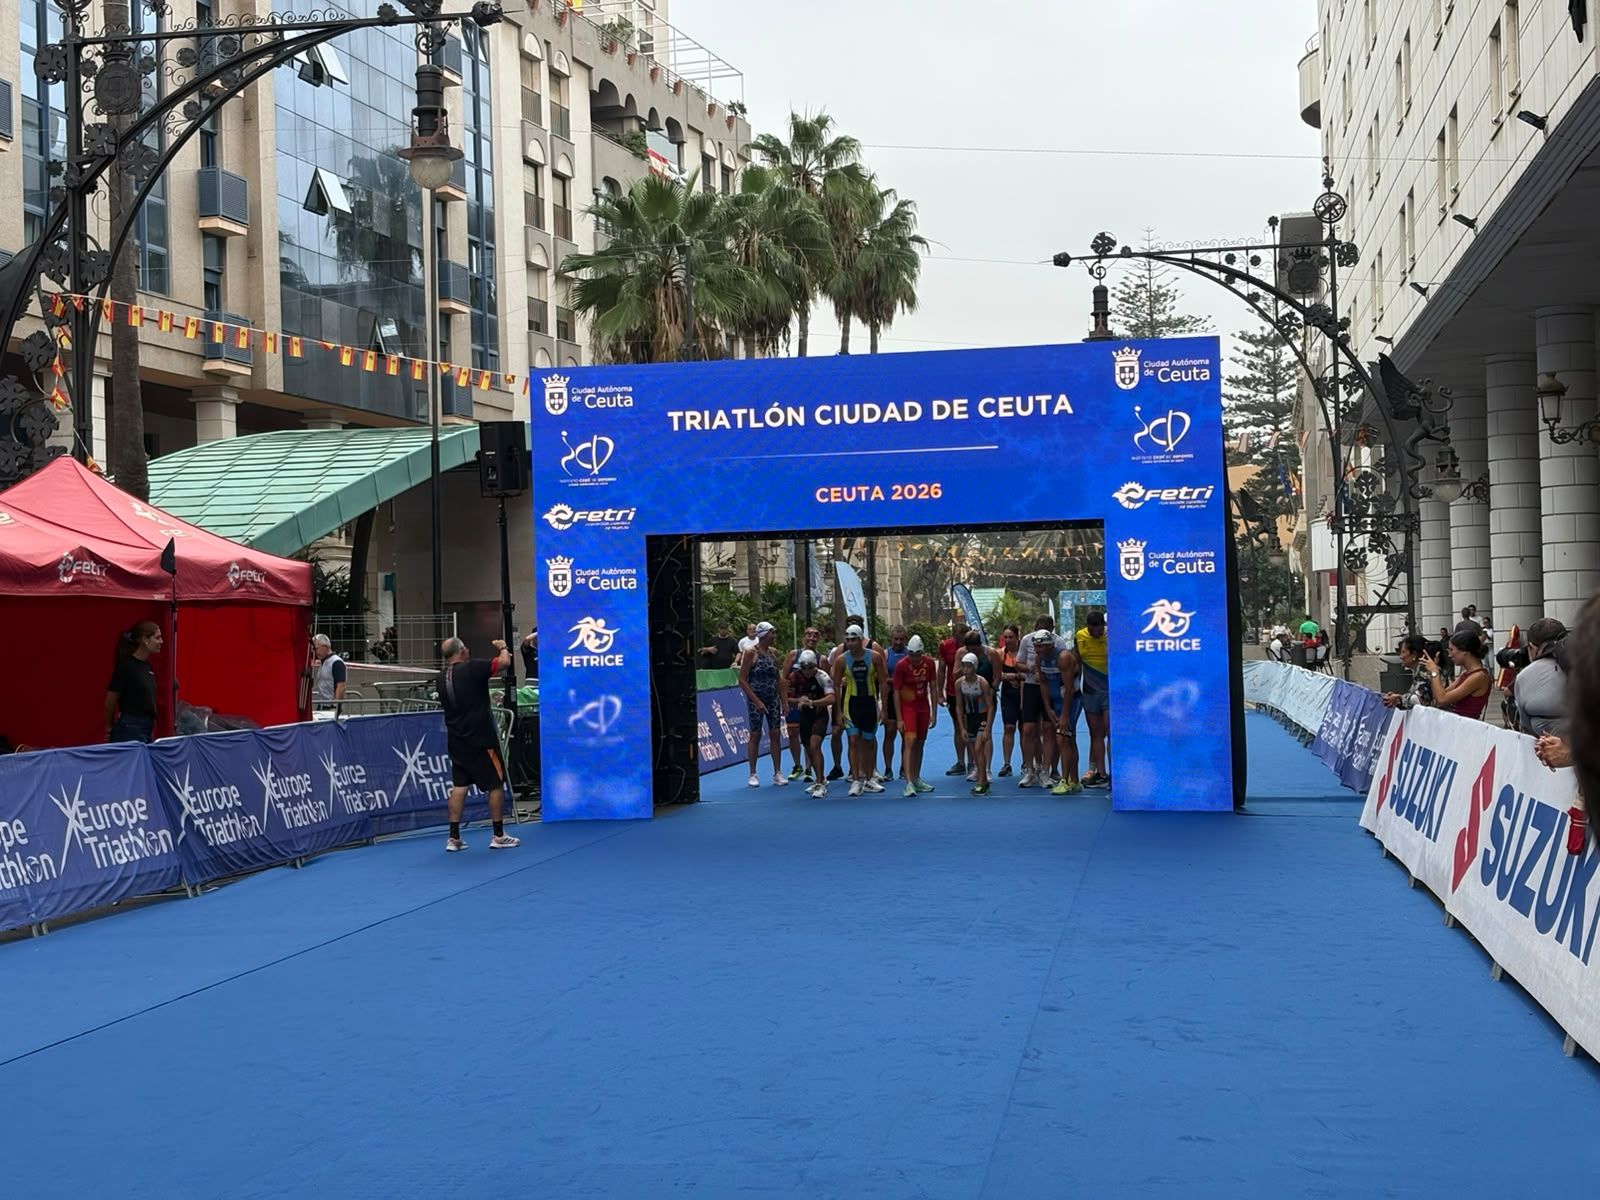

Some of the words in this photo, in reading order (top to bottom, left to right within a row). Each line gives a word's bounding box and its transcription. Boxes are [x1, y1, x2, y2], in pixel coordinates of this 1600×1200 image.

[1144, 360, 1169, 368] Ciudad
[1171, 358, 1210, 366] Autónoma
[1143, 369, 1154, 377] de
[1157, 366, 1210, 383] Ceuta
[584, 393, 634, 409] Ceuta
[667, 402, 805, 432] TRIATLÓN
[814, 401, 923, 426] CIUDAD
[932, 398, 969, 421] DE
[978, 394, 1074, 418] CEUTA
[815, 485, 885, 503] CEUTA
[891, 483, 943, 500] 2026
[1148, 551, 1174, 559] Ciudad
[1176, 550, 1214, 559] Autónoma
[601, 567, 636, 575] Autónoma
[1148, 560, 1159, 568] de
[1162, 559, 1215, 574] Ceuta
[575, 577, 586, 585] de
[588, 576, 637, 591] Ceuta
[1135, 638, 1201, 652] FETRICE
[563, 654, 624, 668] FETRICE
[418, 750, 453, 775] Eur
[270, 772, 313, 799] Europe
[1390, 738, 1459, 844] SUZUKI
[188, 784, 242, 815] Europe
[77, 797, 149, 832] Europe
[276, 798, 329, 830] Triathlon
[194, 812, 264, 847] Triathlon
[84, 827, 175, 869] Triathlon
[0, 852, 57, 890] thlon
